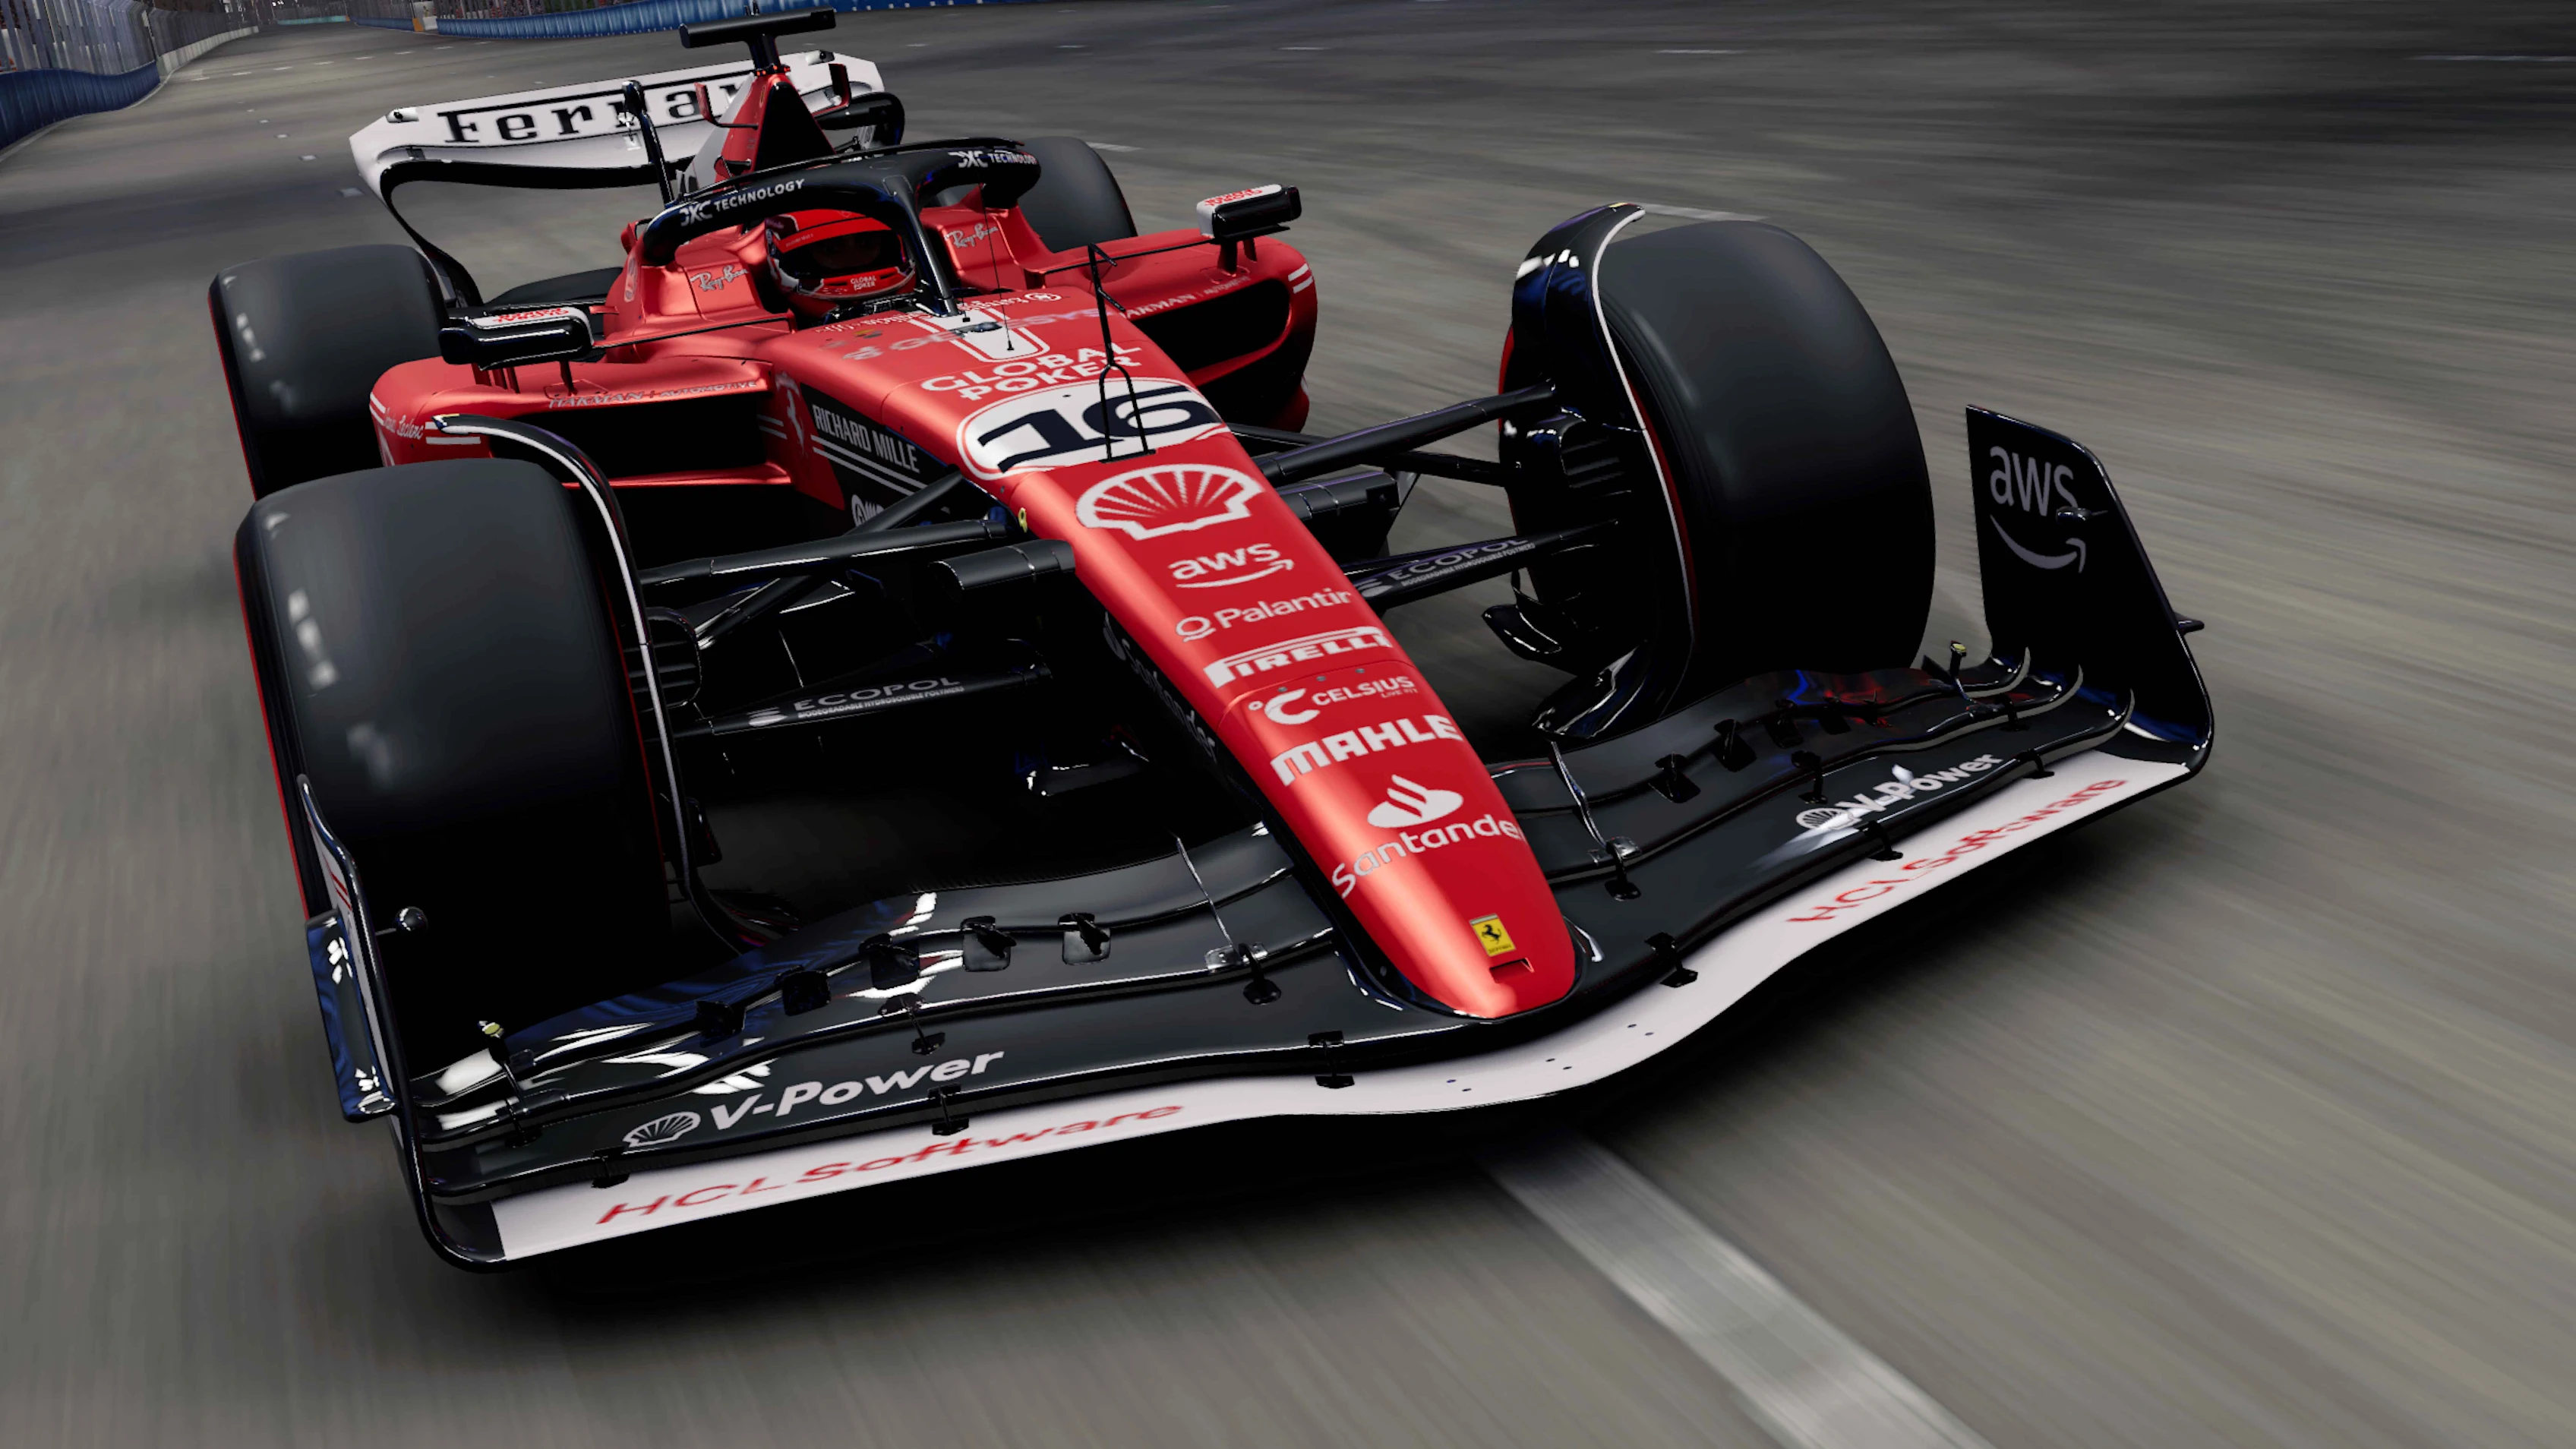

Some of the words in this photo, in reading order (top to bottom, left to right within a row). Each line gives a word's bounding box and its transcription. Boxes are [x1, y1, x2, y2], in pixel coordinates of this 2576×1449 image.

[714, 178, 805, 213] TECHNOLOGY
[690, 264, 748, 292] Ray-Ban
[921, 343, 1142, 391] GLOBAL
[958, 355, 1142, 401] POKER
[812, 403, 873, 453] RICHARD
[872, 430, 920, 473] MILLE
[977, 384, 1224, 473] 16
[1990, 445, 2079, 516] aws
[1168, 543, 1281, 580] aws
[1387, 539, 1530, 580] ECOPOL
[1214, 588, 1351, 629] Palantir
[1204, 626, 1394, 689] PIRELLI
[794, 677, 961, 712] ECOPOL
[1312, 675, 1415, 706] CELSIUS
[1271, 714, 1463, 788] MAHLE
[1835, 752, 2003, 812] V-Power
[711, 1052, 1005, 1132] V-Power
